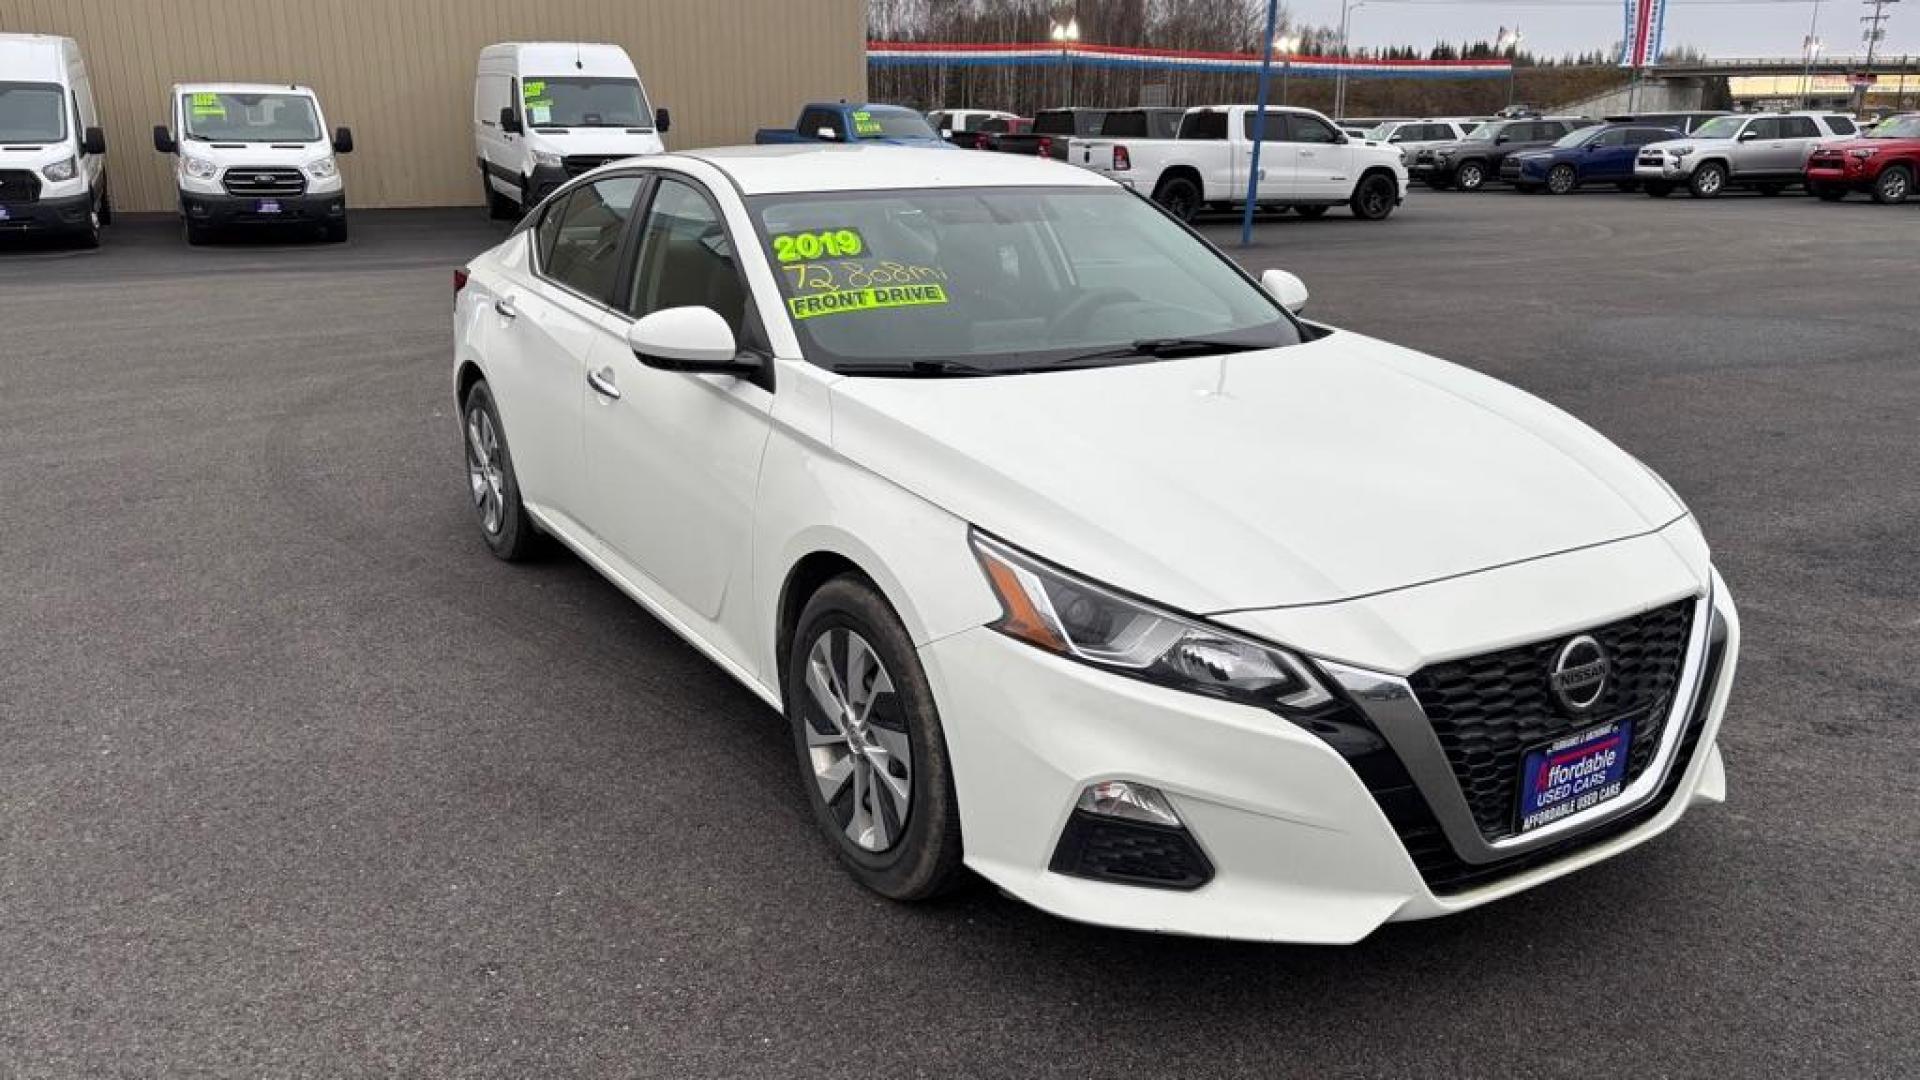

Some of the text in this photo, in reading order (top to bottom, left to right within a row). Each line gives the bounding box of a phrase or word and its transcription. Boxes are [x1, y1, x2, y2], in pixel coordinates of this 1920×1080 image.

[774, 230, 862, 262] 2019
[793, 286, 939, 315] FRONT DRIVE
[1560, 664, 1605, 685] NISSAN
[1537, 771, 1606, 807] USED CARS
